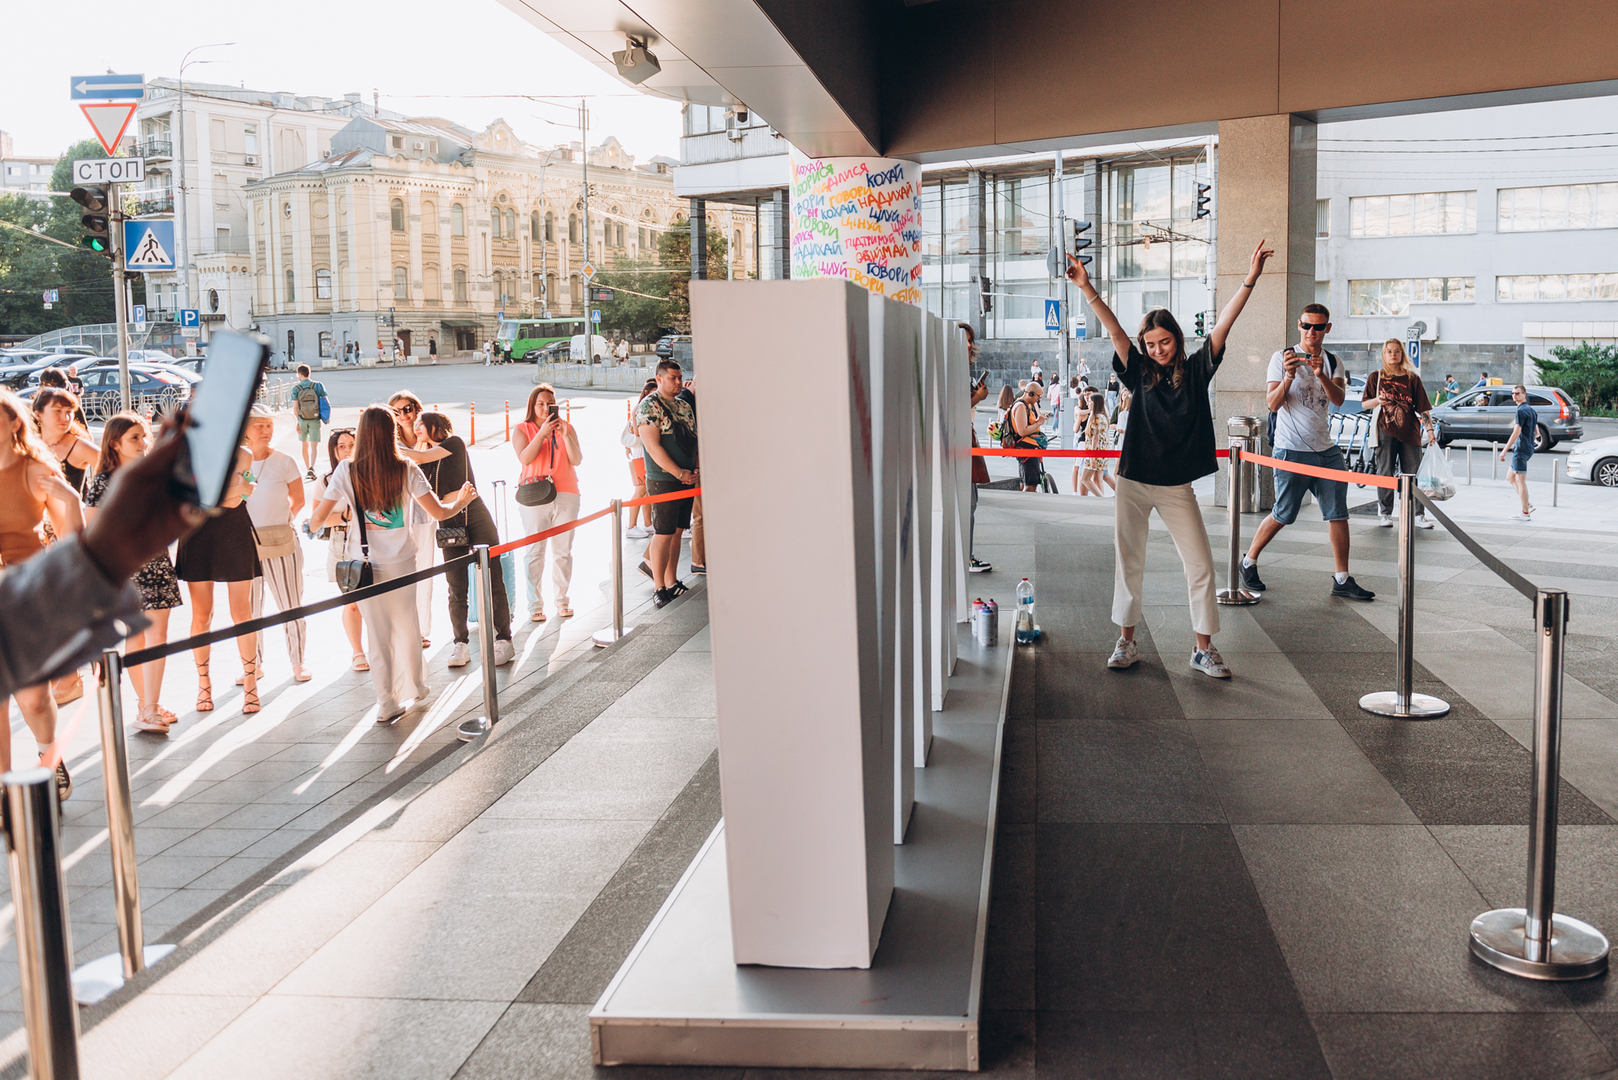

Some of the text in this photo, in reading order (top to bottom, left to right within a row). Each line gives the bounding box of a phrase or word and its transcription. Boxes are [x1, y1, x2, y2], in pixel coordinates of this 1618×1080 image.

[79, 161, 139, 180] СТОП
[796, 160, 824, 177] КОХАЙ
[796, 163, 834, 197] БОРИСЯ
[827, 162, 869, 192] ДІЛИСЯ
[866, 163, 904, 188] КОХАЙ
[793, 194, 825, 217] ТВОРИ
[829, 185, 873, 208] ГОВОРИ
[857, 181, 914, 210] НАДИХАЙ
[820, 200, 858, 220] КОХАЙ
[799, 214, 839, 240] ГОВОРИ
[841, 215, 882, 234] ЦІНУЙ
[793, 240, 843, 265] НАДИХАЙ
[844, 233, 896, 250] ПІДТРИМУЙ
[846, 266, 884, 295] ТВОРИ
[866, 262, 909, 287] ГОВОРИ
[136, 307, 143, 322] P
[184, 310, 196, 326] P
